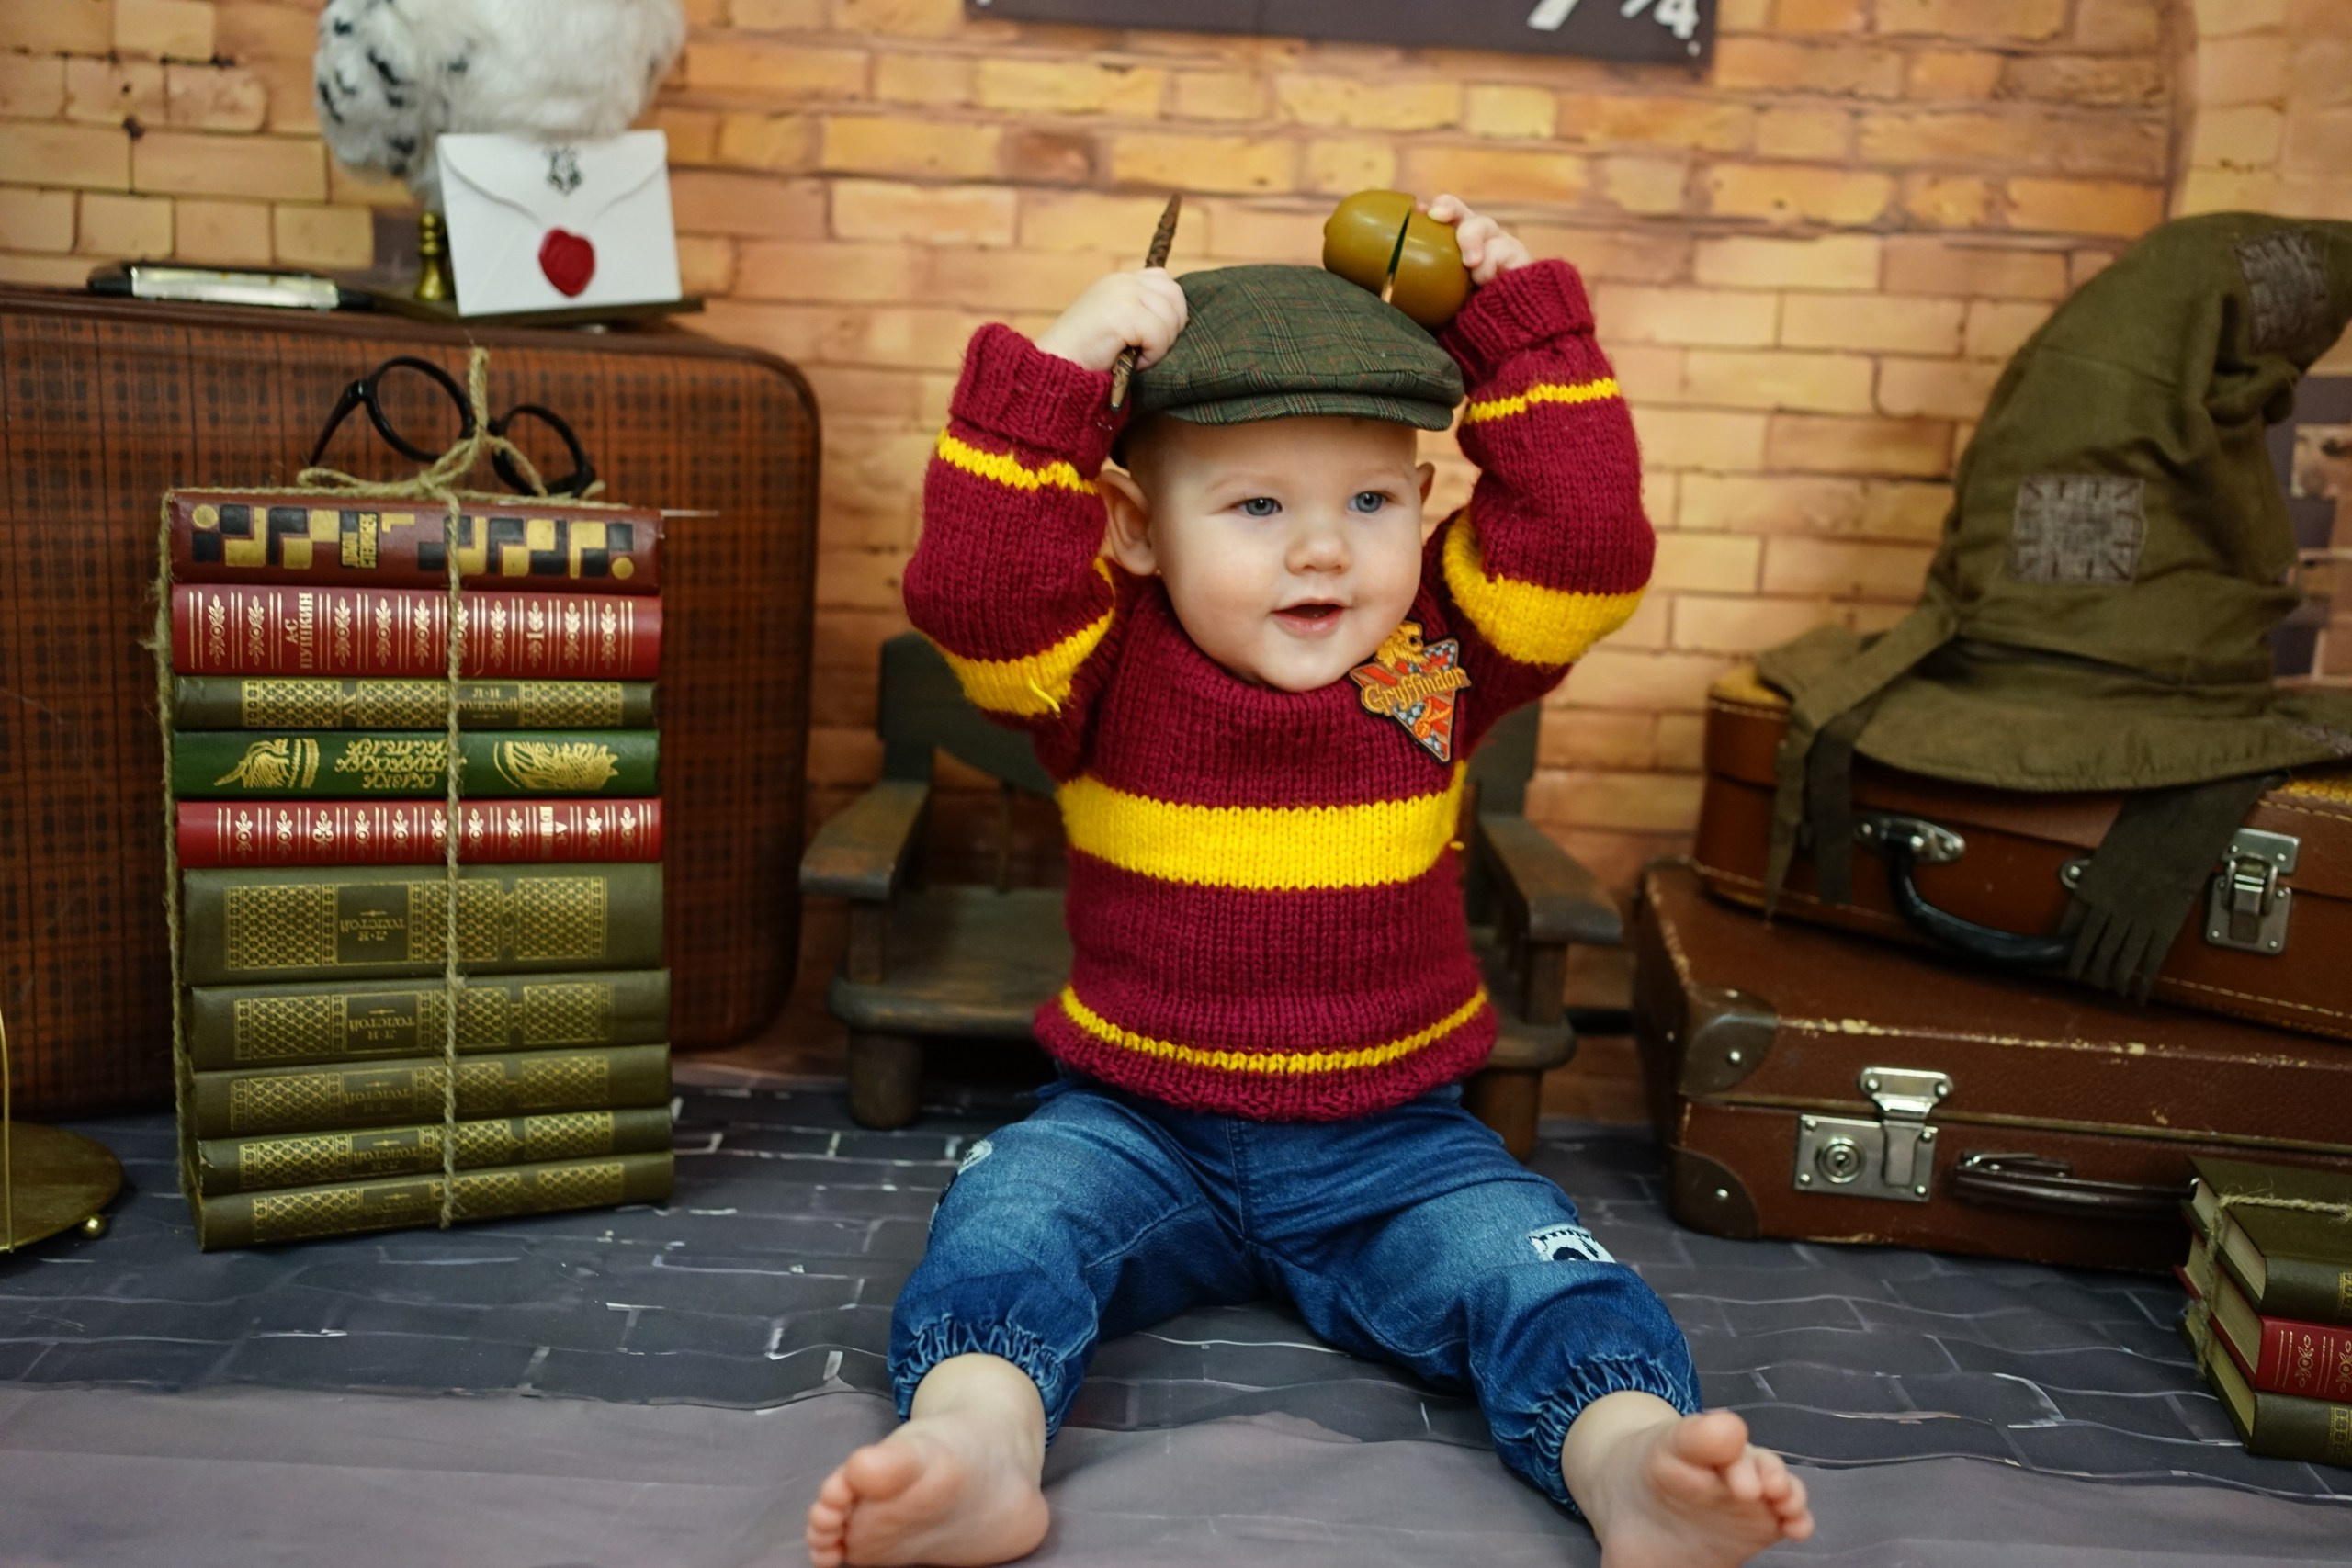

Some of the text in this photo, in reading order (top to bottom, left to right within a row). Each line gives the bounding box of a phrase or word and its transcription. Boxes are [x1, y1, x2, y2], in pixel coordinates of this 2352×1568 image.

[299, 592, 313, 670] ПУШКИН
[1363, 667, 1465, 716] Gryffindor
[345, 738, 451, 757] ИСАТЕЛЕЙ
[339, 918, 407, 933] ТОЛСТОЙ
[348, 1016, 416, 1032] ТОЛСТОЙ
